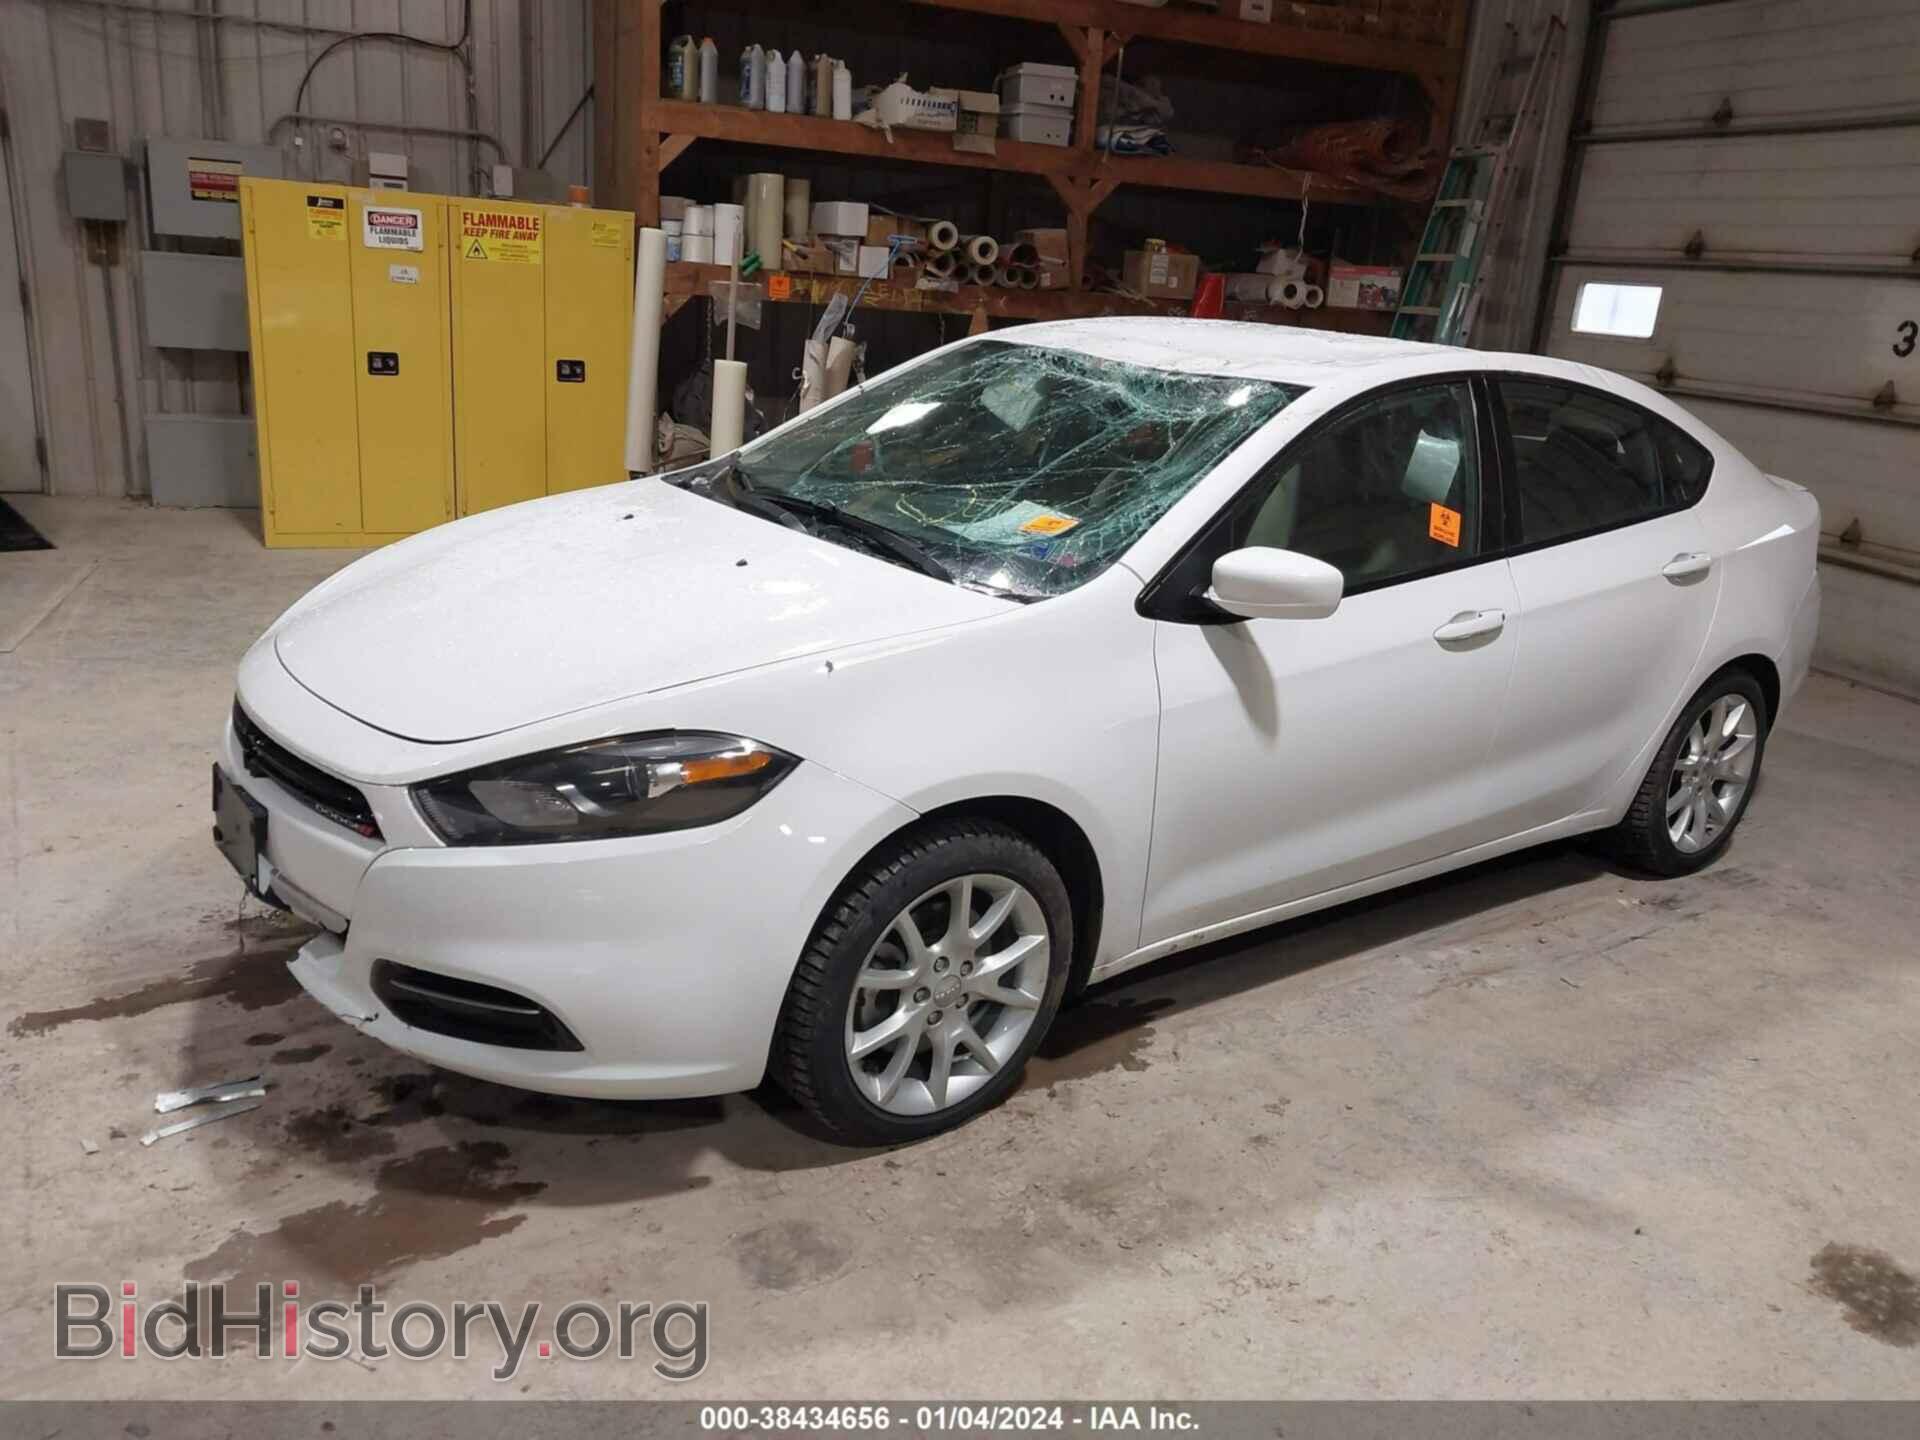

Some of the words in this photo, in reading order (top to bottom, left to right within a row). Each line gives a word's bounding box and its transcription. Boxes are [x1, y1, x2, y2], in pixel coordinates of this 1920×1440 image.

[372, 214, 414, 226] DANGER
[463, 212, 540, 231] FLAMMABLE
[369, 227, 417, 238] FLAMMABLE
[463, 227, 488, 238] KEEP
[489, 229, 512, 240] FIRE
[512, 230, 539, 241] AWAY
[378, 236, 409, 245] LIQUIDS
[1892, 320, 1919, 358] 3
